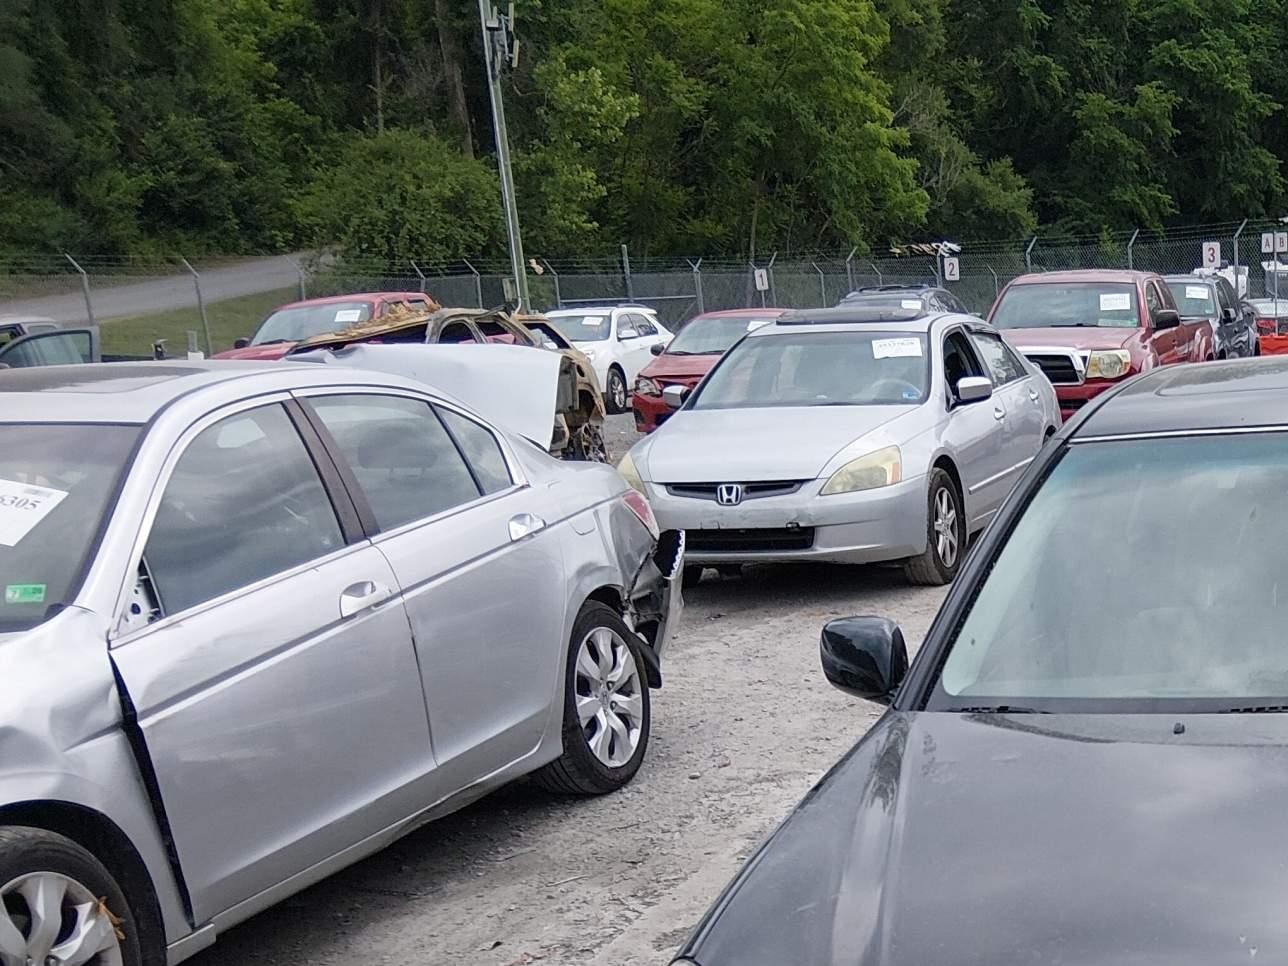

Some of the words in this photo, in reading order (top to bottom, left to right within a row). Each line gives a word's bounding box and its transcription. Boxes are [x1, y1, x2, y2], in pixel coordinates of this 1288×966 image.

[1263, 237, 1271, 249] A
[1279, 236, 1285, 248] B
[1207, 246, 1216, 263] 3
[948, 261, 956, 277] 2
